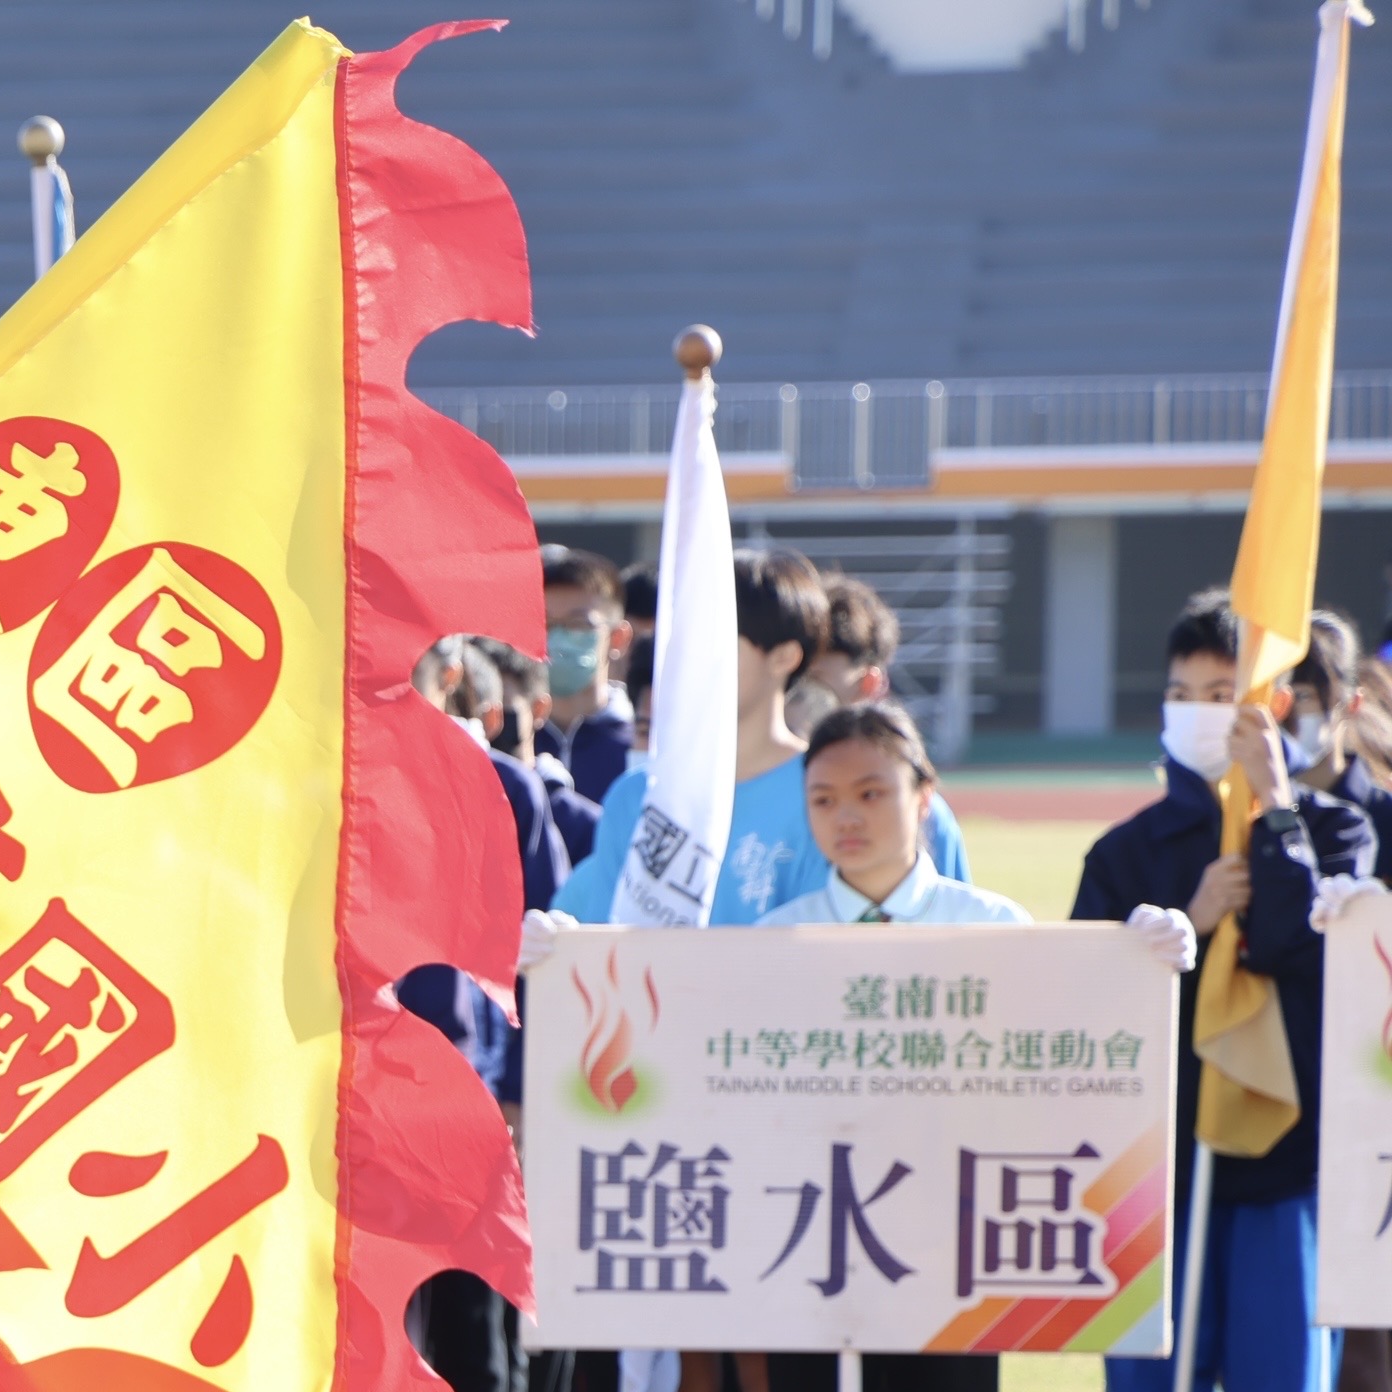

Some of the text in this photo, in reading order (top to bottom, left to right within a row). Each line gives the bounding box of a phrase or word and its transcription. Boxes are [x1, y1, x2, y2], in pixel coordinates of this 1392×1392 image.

[842, 975, 989, 1020] 臺南市
[706, 1029, 1144, 1070] 中等學校聯合運動會
[707, 1075, 1143, 1096] TAINAN MIDDLE SCHOOL ATHLETIC GAMES
[574, 1140, 1105, 1298] 鹽水區
